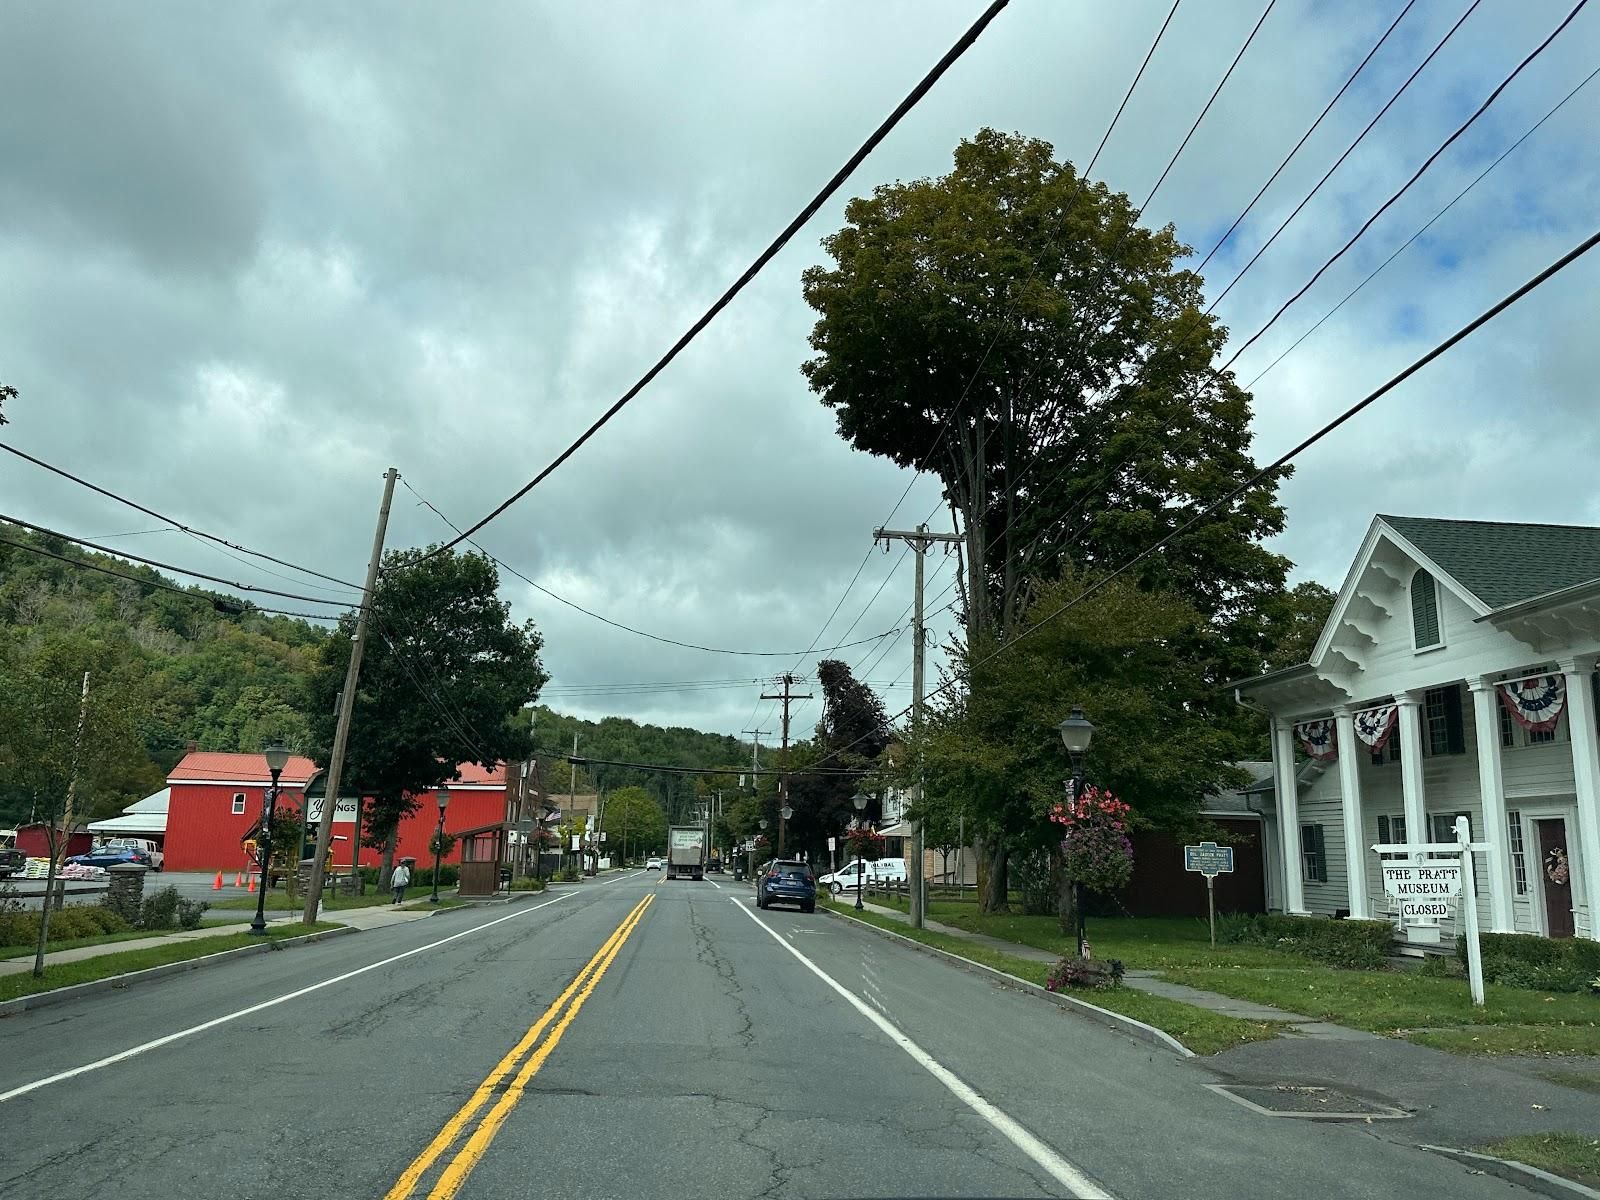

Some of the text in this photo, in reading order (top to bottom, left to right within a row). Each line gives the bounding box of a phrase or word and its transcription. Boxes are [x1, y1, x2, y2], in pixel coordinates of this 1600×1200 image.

[310, 799, 356, 820] YNGS
[1386, 869, 1458, 880] THE PRATT
[1397, 883, 1450, 894] MUSEUM
[1404, 904, 1447, 915] CLOSED
